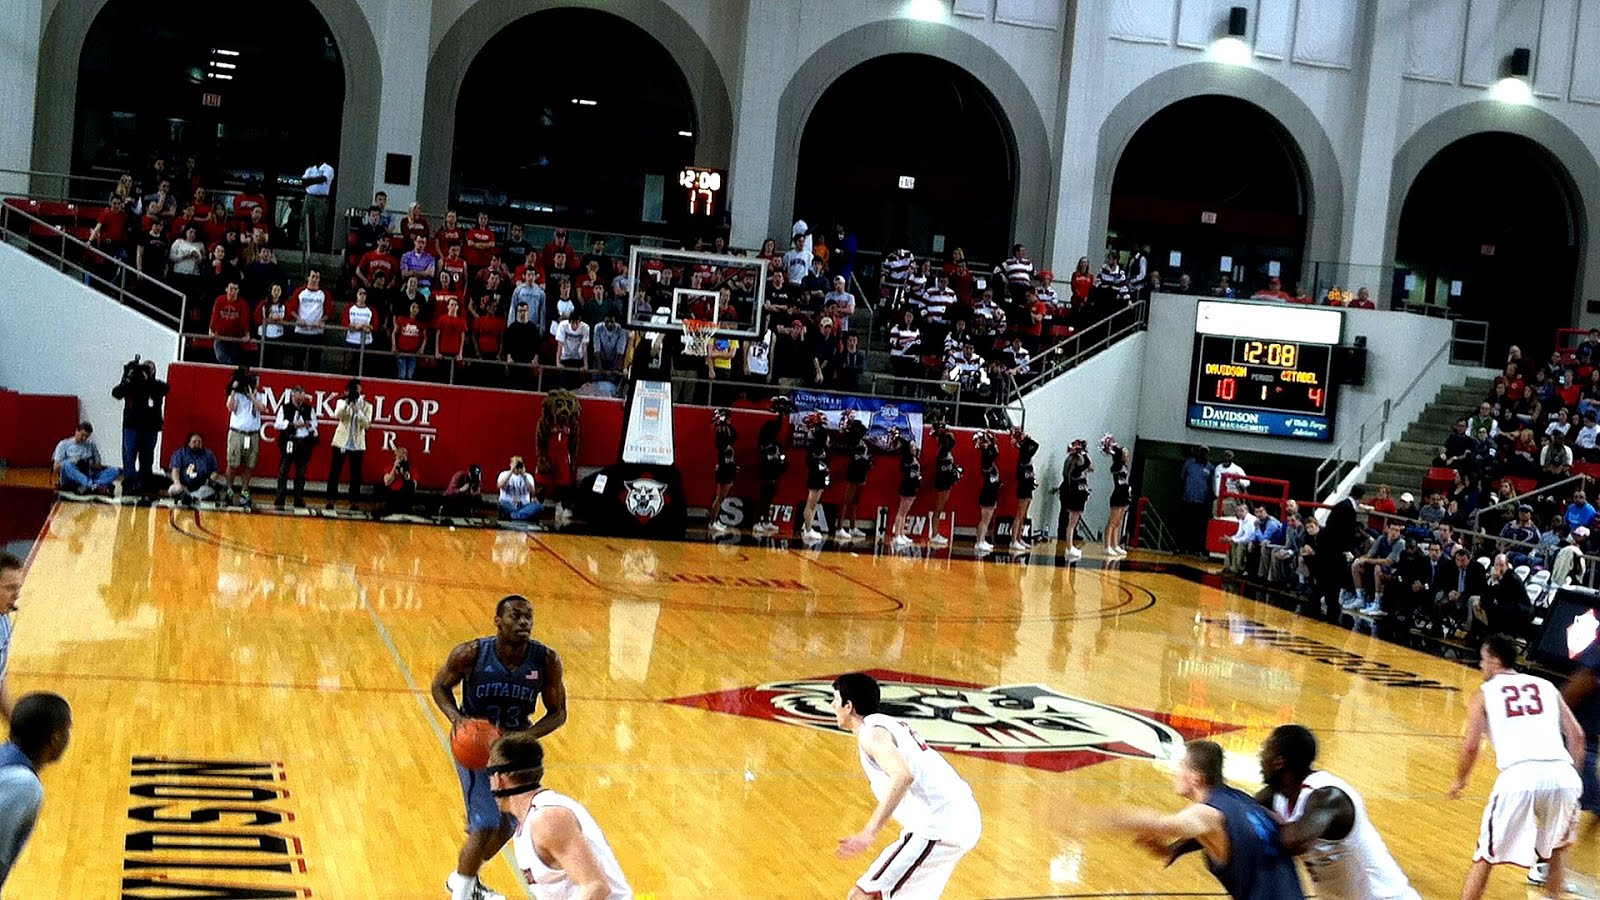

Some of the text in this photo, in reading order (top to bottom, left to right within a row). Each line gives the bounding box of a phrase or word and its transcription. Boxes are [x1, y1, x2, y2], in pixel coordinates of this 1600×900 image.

[690, 189, 712, 216] 17
[1244, 341, 1296, 367] 12:08
[1206, 363, 1247, 378] DAVIDSON
[1215, 378, 1235, 401] 10
[1308, 387, 1322, 408] 4
[262, 386, 439, 426] MKLOP
[1202, 406, 1259, 424] DAVIDSON
[475, 682, 535, 702] CITADEL
[1501, 683, 1544, 717] 23
